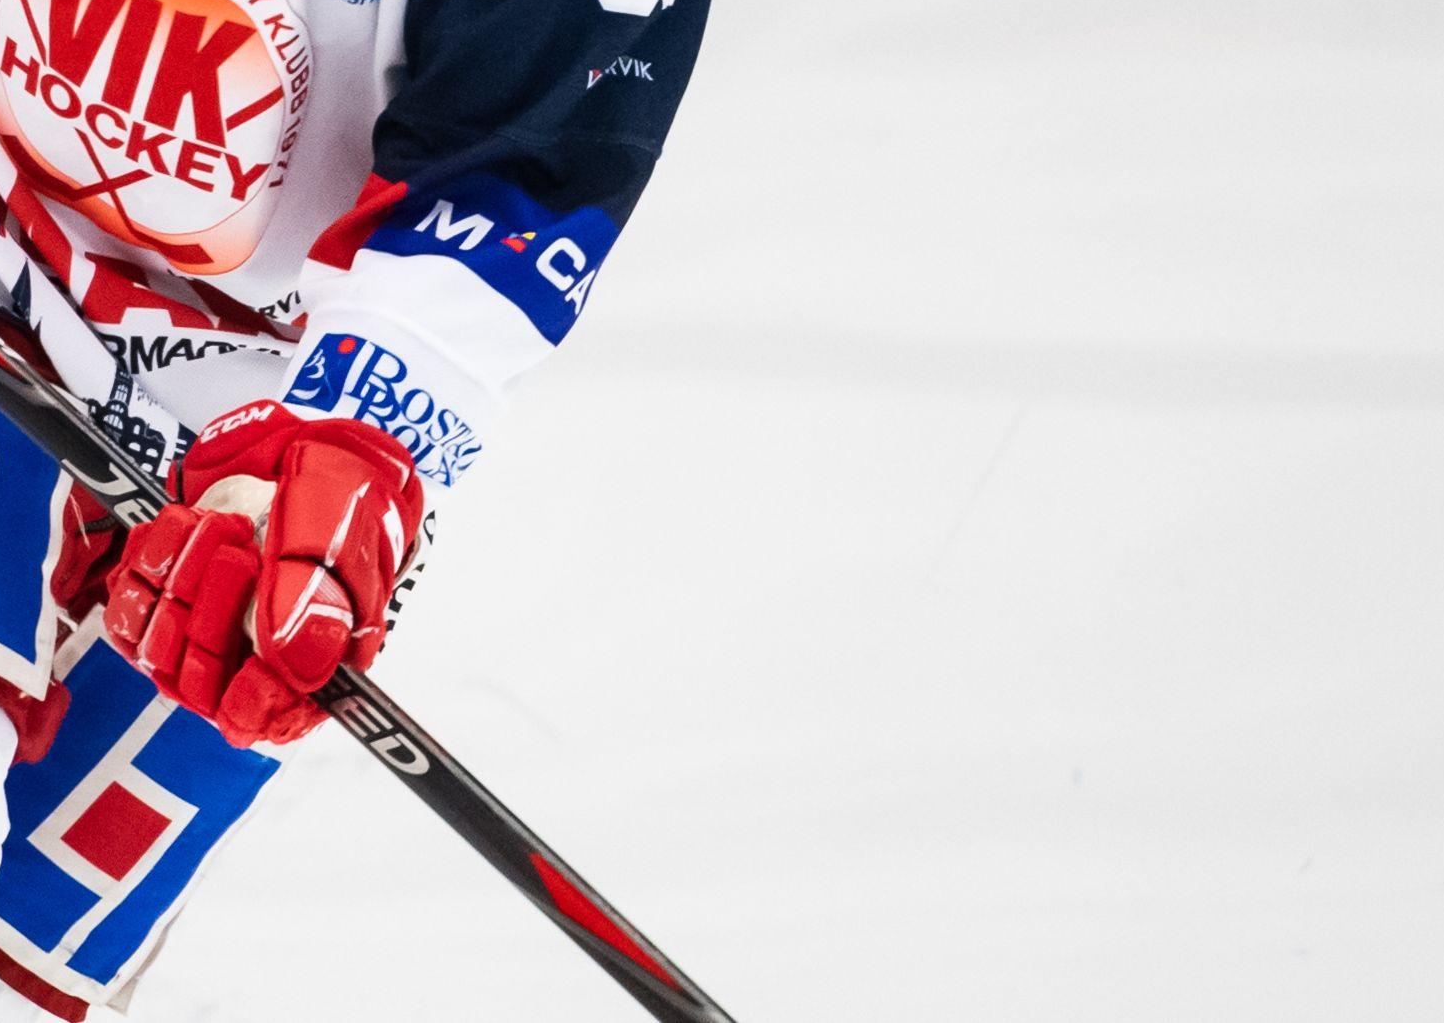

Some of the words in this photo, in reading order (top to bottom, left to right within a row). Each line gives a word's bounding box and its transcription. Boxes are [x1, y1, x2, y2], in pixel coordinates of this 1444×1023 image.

[262, 12, 311, 115] KLUBB
[0, 35, 272, 202] HOCKEY
[200, 403, 276, 445] CCM
